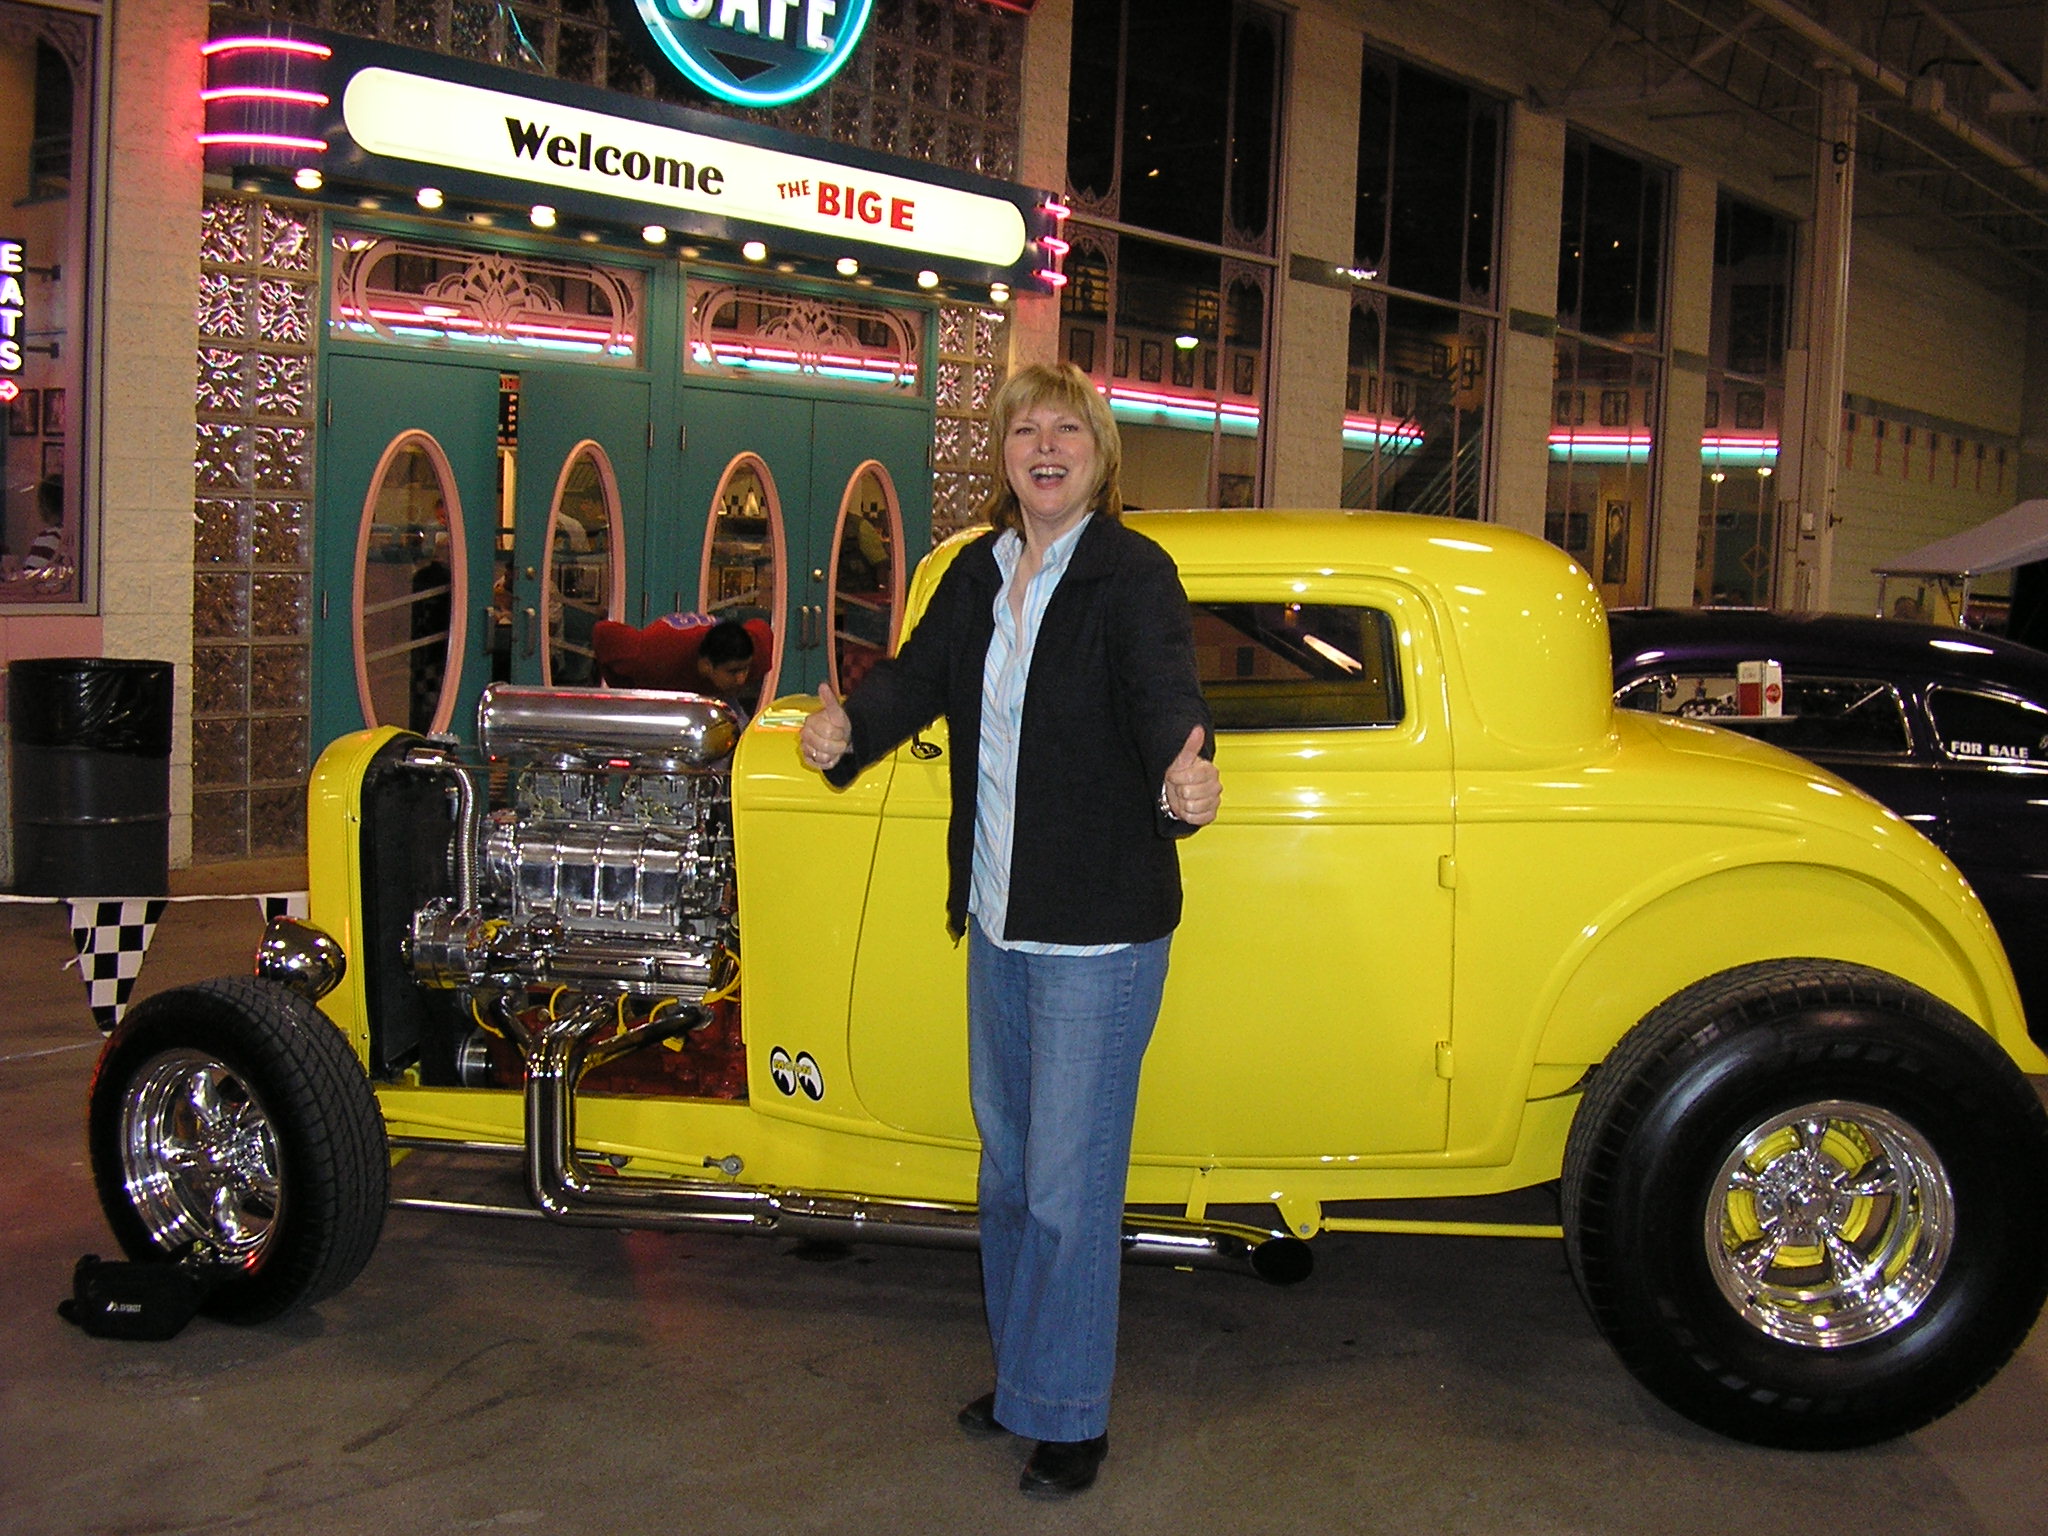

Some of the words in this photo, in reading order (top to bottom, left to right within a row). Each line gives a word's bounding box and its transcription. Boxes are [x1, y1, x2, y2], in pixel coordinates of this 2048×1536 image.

[505, 117, 724, 195] Welcome
[777, 179, 811, 199] THE
[818, 181, 882, 224] BIG
[0, 243, 24, 371] EATS
[1951, 741, 1982, 755] FOR
[1989, 744, 2029, 759] SALE
